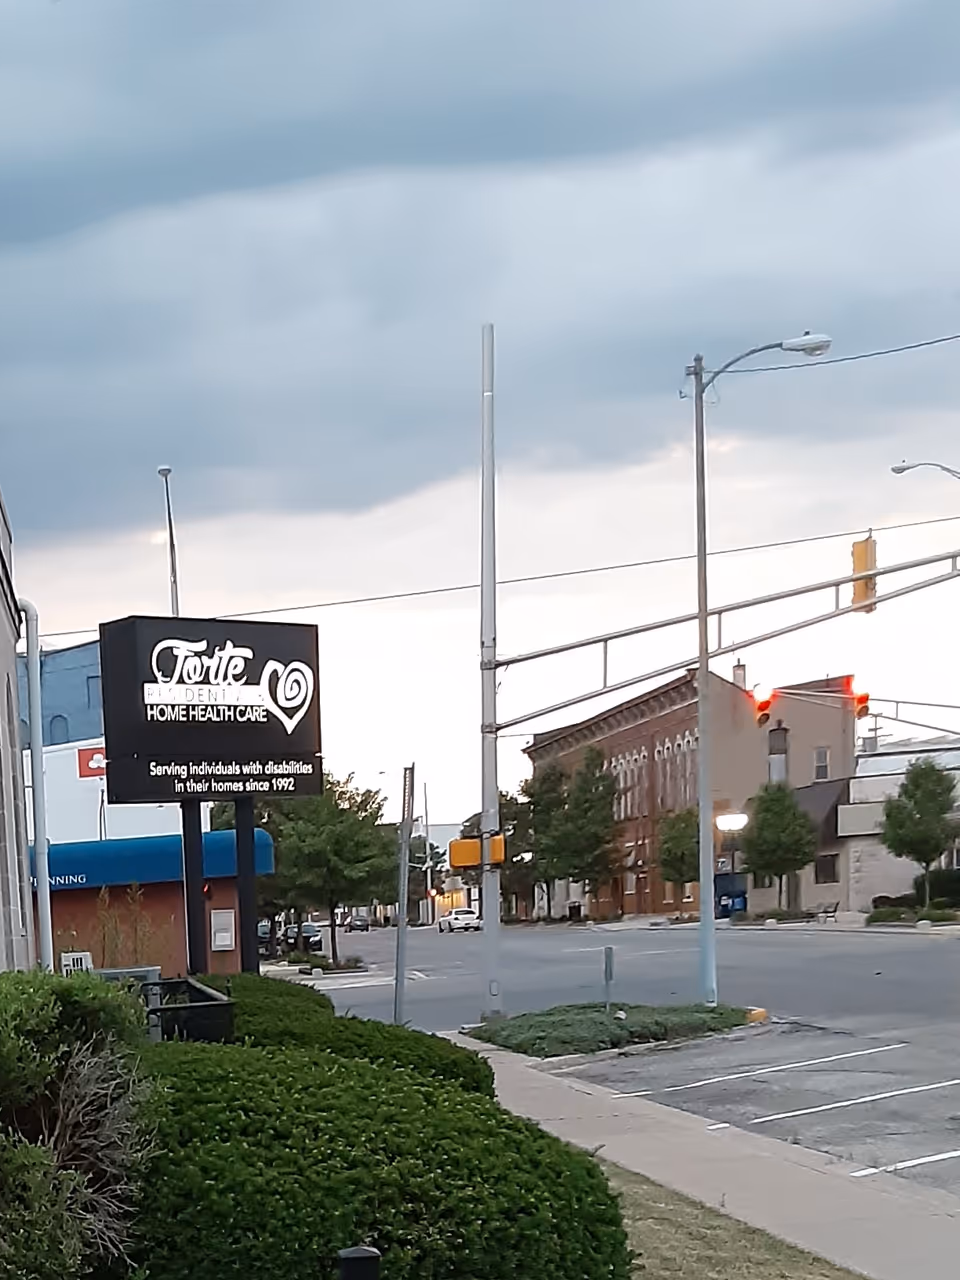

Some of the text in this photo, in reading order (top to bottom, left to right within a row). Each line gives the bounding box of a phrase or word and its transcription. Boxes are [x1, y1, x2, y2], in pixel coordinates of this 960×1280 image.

[147, 705, 267, 721] HOME HEALTH CARE
[150, 760, 313, 778] Serving individuals with disabilities
[175, 777, 295, 793] in their homes since 1992
